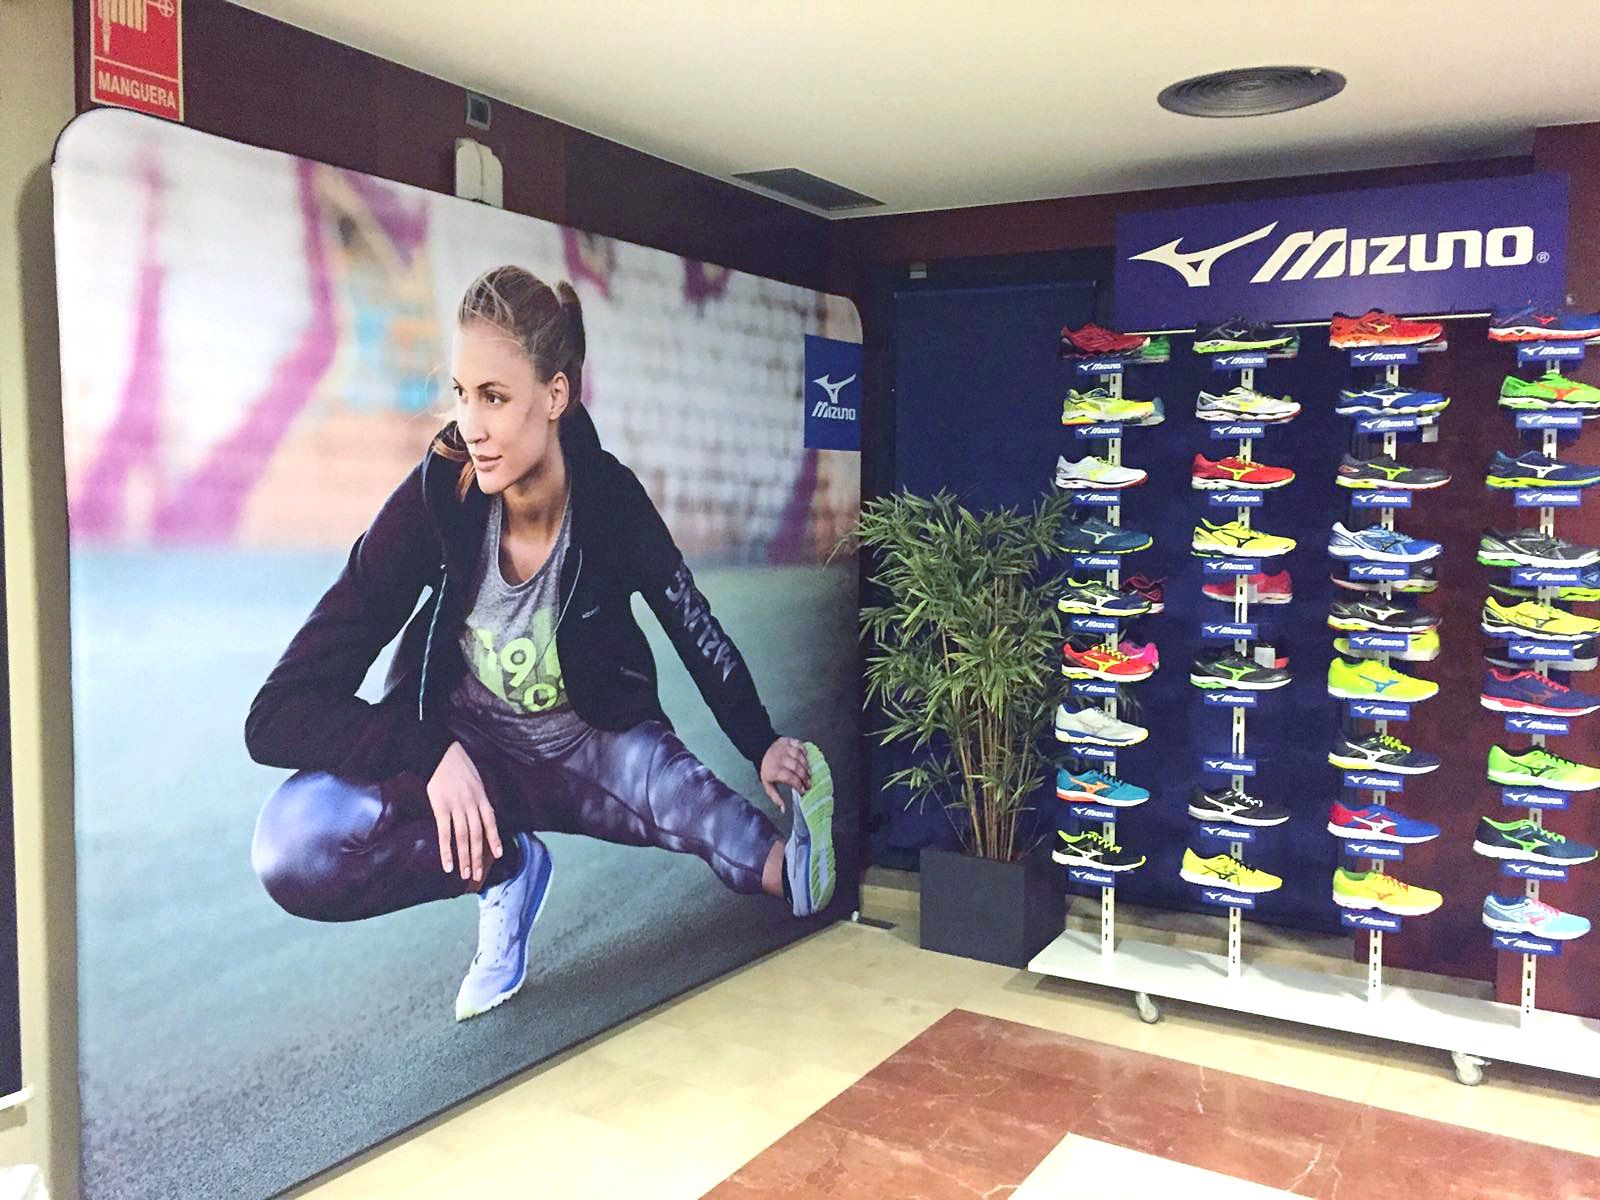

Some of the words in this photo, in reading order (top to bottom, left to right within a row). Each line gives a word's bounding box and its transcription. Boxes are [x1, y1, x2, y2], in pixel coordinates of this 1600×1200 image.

[98, 71, 177, 110] MANGUERA
[1250, 226, 1534, 284] MIZUNO
[811, 401, 856, 421] MIZUNO
